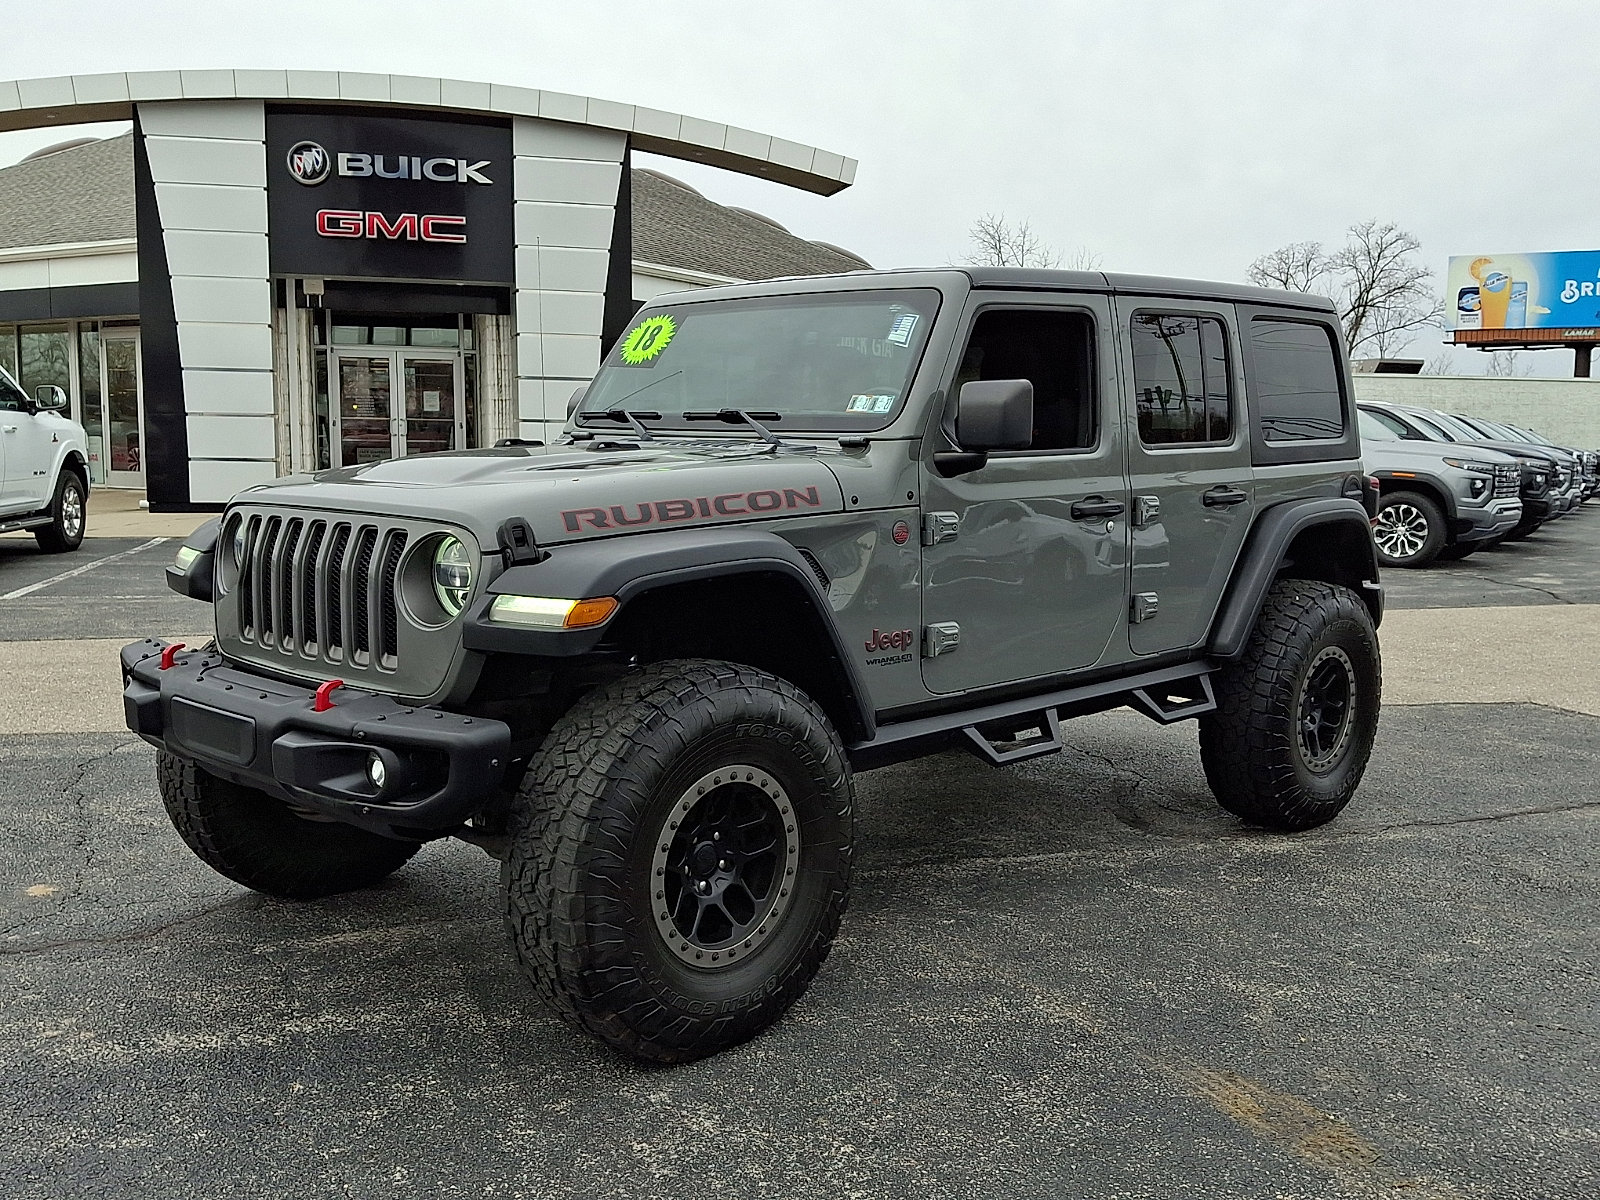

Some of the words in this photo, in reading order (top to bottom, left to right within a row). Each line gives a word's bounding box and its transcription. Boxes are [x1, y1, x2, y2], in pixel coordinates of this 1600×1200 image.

[337, 152, 493, 184] BUICK
[316, 208, 467, 244] GMC
[632, 325, 663, 351] 18
[1564, 329, 1596, 337] LAMAR
[560, 486, 821, 533] RUBICON
[864, 628, 914, 652] Jeep
[866, 653, 913, 665] WRANGLER
[735, 723, 794, 746] TOYO
